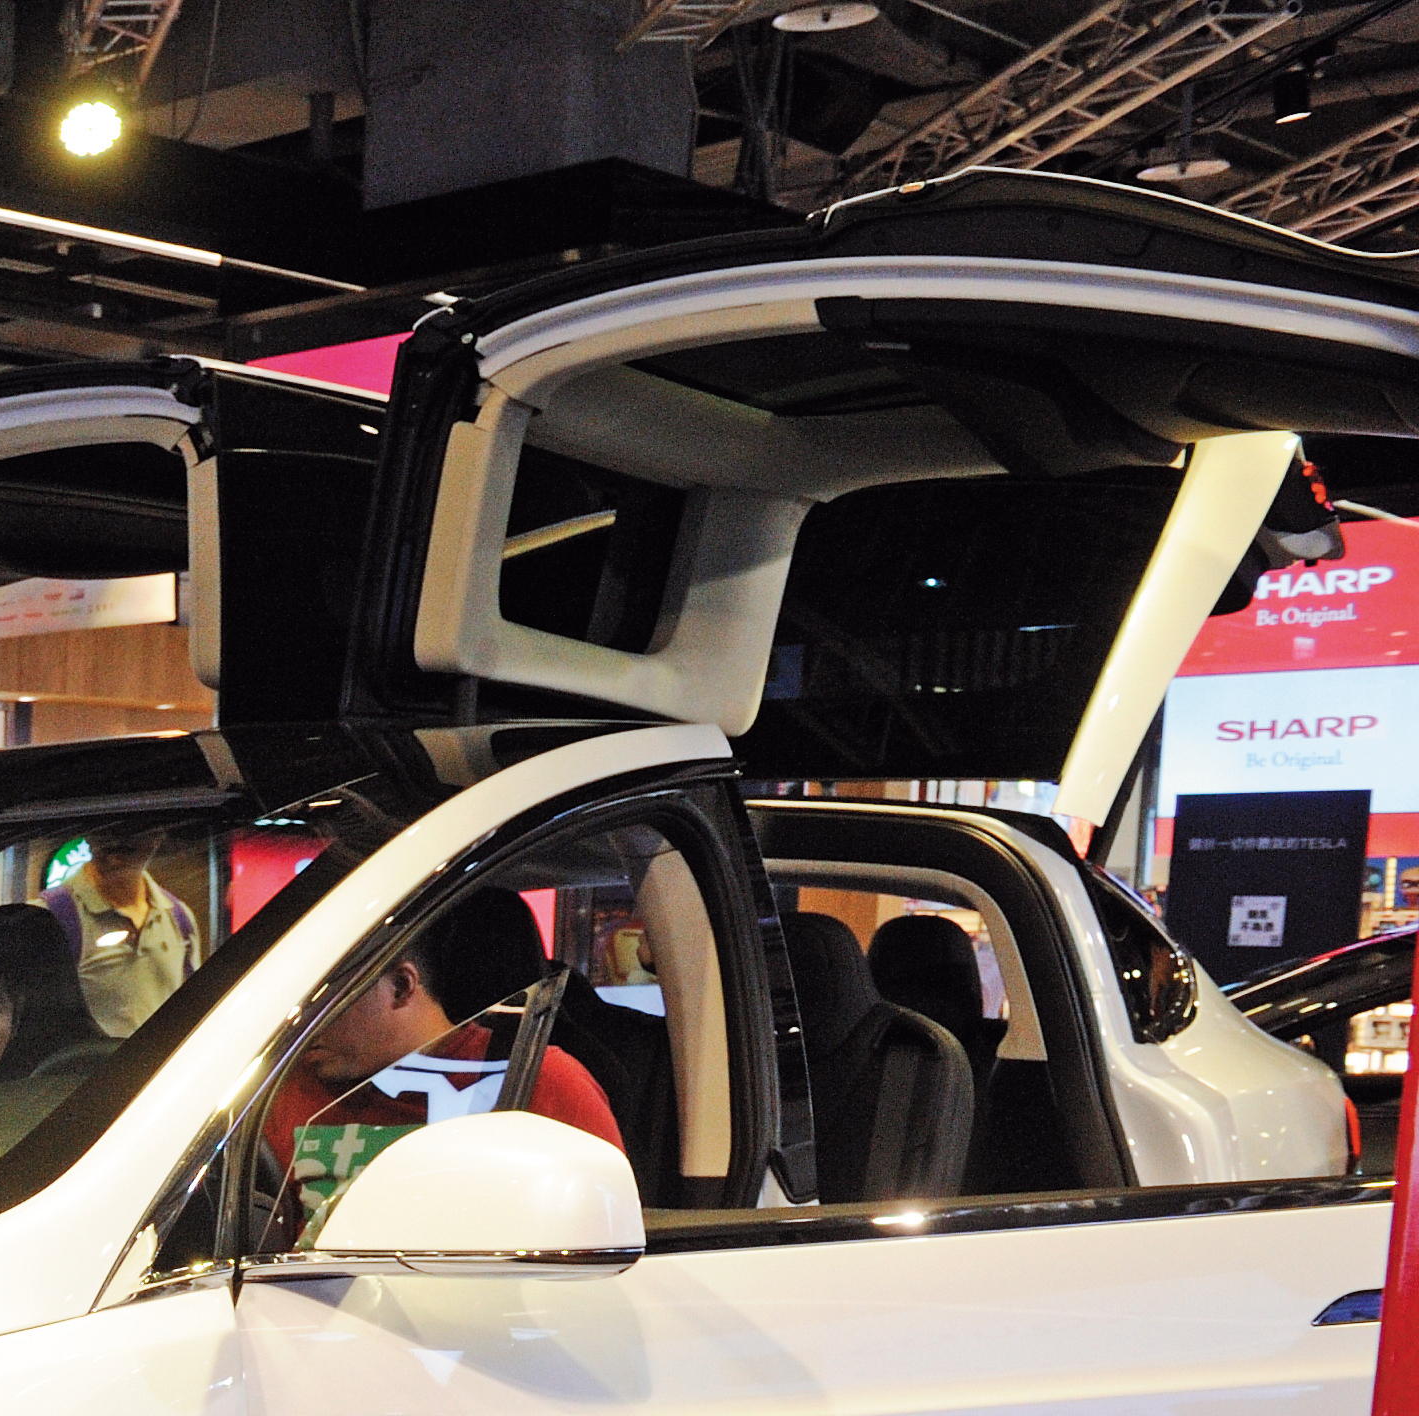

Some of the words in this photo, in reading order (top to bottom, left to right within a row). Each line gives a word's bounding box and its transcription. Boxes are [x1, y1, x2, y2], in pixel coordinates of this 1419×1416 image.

[1256, 609, 1280, 626] Be
[1216, 715, 1378, 741] SHARP
[1246, 752, 1267, 768] Be
